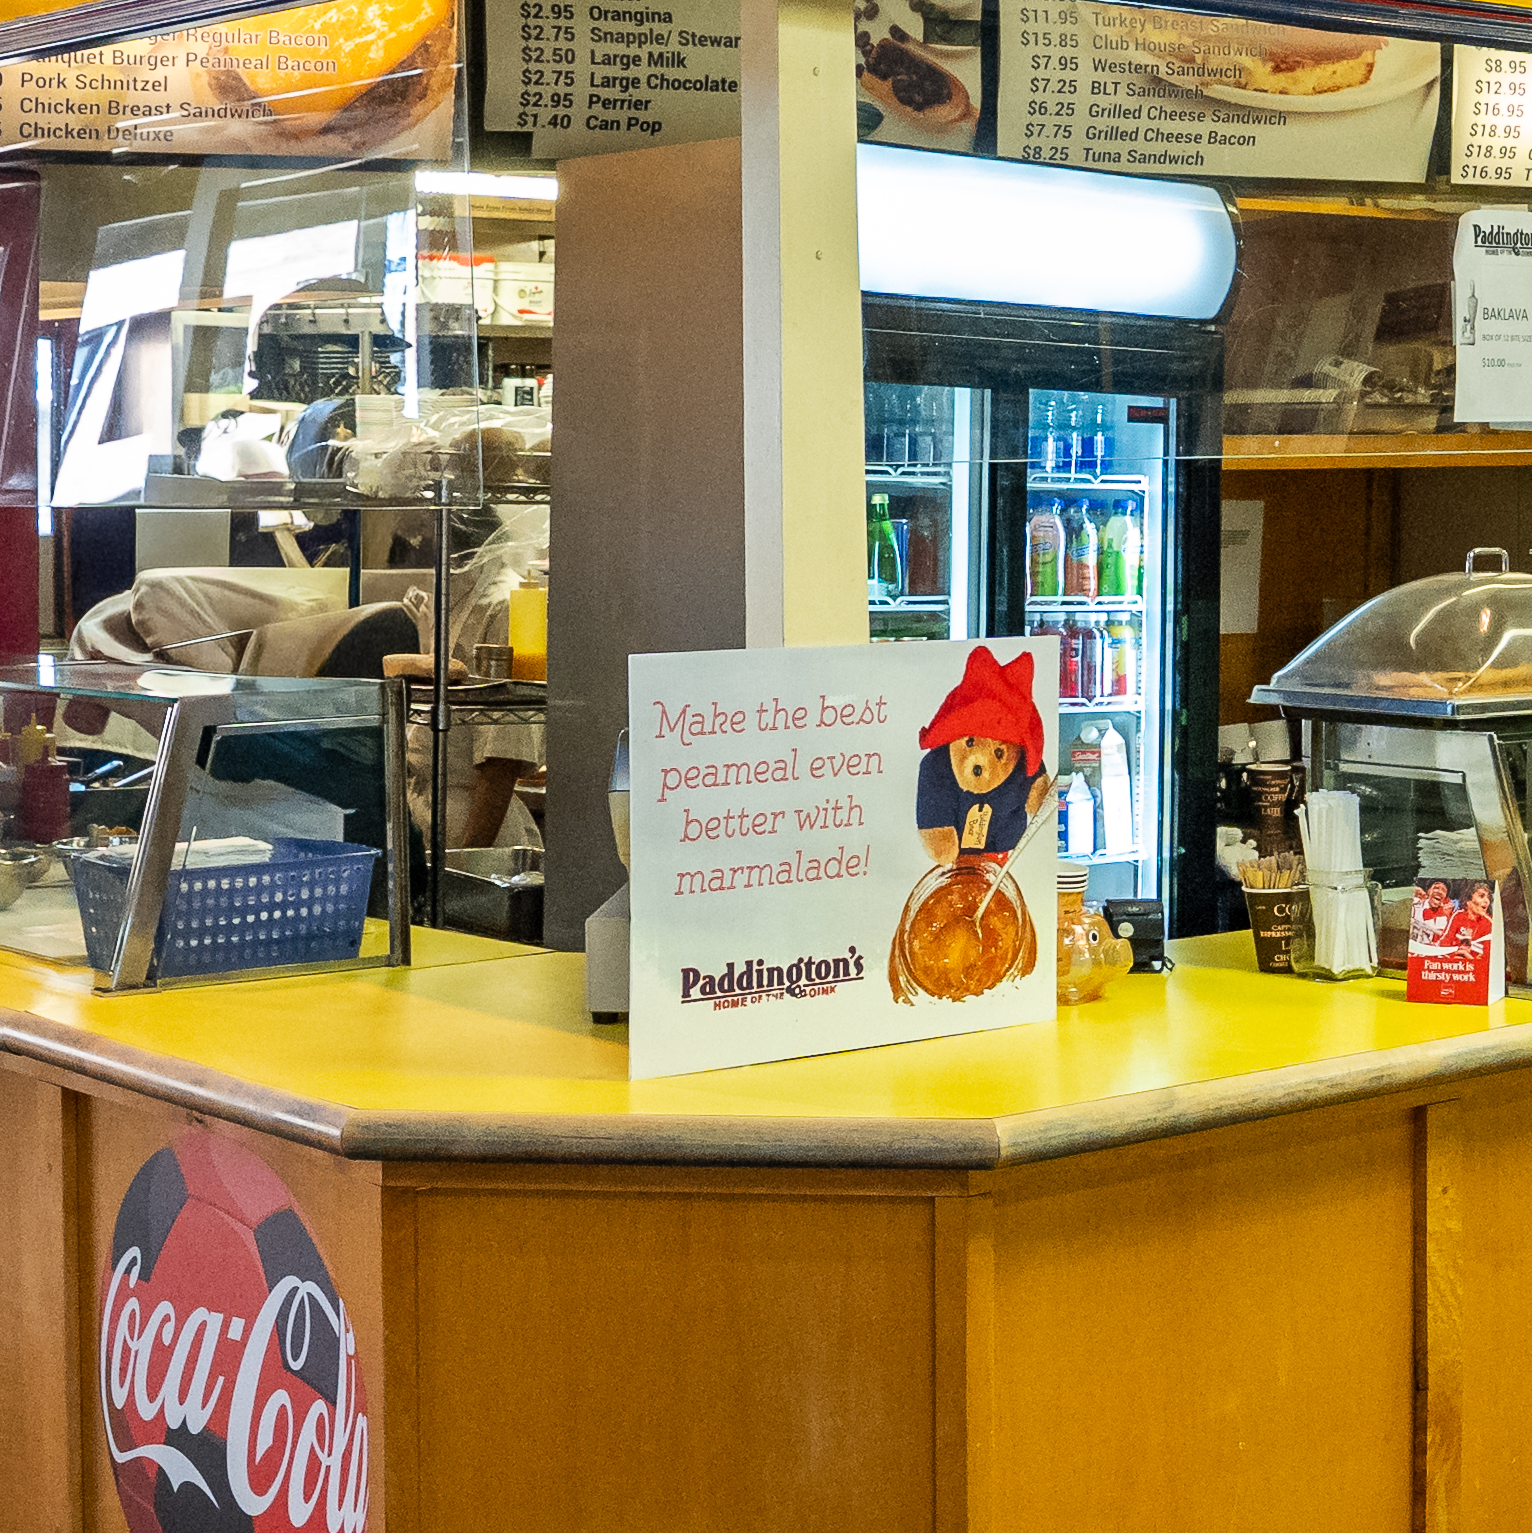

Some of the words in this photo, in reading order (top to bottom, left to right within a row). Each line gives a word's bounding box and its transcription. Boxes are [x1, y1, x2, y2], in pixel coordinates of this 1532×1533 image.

[520, 1, 575, 21] $2.95
[589, 6, 673, 27] Orangina
[1020, 8, 1079, 25] $11.95
[1092, 12, 1146, 32] Turkey
[1152, 15, 1204, 32] Breast
[1209, 18, 1286, 36] Sandwich
[186, 28, 261, 47] Regular
[269, 30, 329, 47] Bacon
[521, 23, 575, 42] $2.75
[590, 27, 673, 49] Snapple/
[678, 30, 741, 49] Stewar
[1021, 31, 1079, 49] $15.85
[1093, 34, 1129, 51] Club
[1135, 38, 1185, 55] House
[1192, 40, 1268, 58] Sandwich
[113, 50, 178, 70] Burger
[186, 52, 270, 70] Peameal
[277, 55, 336, 73] Bacon
[521, 45, 576, 64] $2.50
[590, 49, 642, 70] Large
[648, 51, 688, 69] Milk
[1031, 54, 1079, 72] $7.95
[1092, 58, 1160, 75] Western
[1165, 61, 1243, 79] Sandwich
[1485, 58, 1527, 74] $8.95
[21, 72, 67, 89] Pork
[76, 74, 168, 92] Schnitzel
[521, 67, 575, 87] $2.75
[590, 72, 641, 93] Large
[646, 74, 738, 93] Chocolate
[1030, 77, 1077, 95] $7.25
[1091, 80, 1121, 96] BLT
[1126, 82, 1204, 101] Sandwich
[1475, 80, 1527, 97] $12.95
[20, 97, 100, 115] Chicken
[108, 100, 172, 117] Breast
[179, 102, 273, 120] Sandwich
[519, 90, 573, 109] $2.95
[587, 94, 652, 112] Perrier
[1473, 101, 1524, 118] $16.95
[517, 111, 572, 129] $1.40
[586, 116, 620, 131] Can
[627, 117, 662, 136] Pop
[1027, 100, 1075, 118] $6.25
[1089, 103, 1142, 121] Grilled
[1147, 106, 1206, 123] Cheese
[1211, 108, 1287, 126] Sandwich
[19, 122, 99, 140] Chicken
[107, 124, 174, 142] Deluxe
[1024, 123, 1073, 140] $7.75
[1085, 125, 1139, 143] Grilled
[1144, 128, 1203, 145] Cheese
[1207, 131, 1256, 147] Bacon
[1469, 123, 1521, 140] $18.95
[1021, 145, 1069, 162] $8.25
[1083, 147, 1121, 164] Tuna
[1127, 148, 1205, 166] Sandwich
[1465, 144, 1517, 160] $18.95
[1461, 164, 1513, 181] $16.95
[1482, 307, 1529, 322] BAKLAVA
[1481, 334, 1493, 342] BOX
[1495, 334, 1503, 342] OF
[1481, 357, 1506, 368] $10.00
[653, 699, 748, 747] Make
[756, 696, 811, 733] the
[816, 693, 889, 730] best
[657, 747, 800, 803] peameal
[809, 749, 884, 779] even
[679, 807, 786, 843] better
[793, 794, 865, 833] with
[673, 844, 871, 897] marmalade!
[680, 945, 865, 999] Paddington's
[1421, 970, 1452, 983] thirsty
[1452, 971, 1476, 982] work
[1424, 959, 1441, 970] Fan
[1441, 960, 1465, 971] work
[1466, 961, 1475, 971] is
[713, 996, 748, 1012] HOME
[750, 994, 764, 1005] OF
[766, 992, 785, 1003] THE
[808, 984, 838, 999] OINK
[99, 1245, 369, 1533] Coca-Cola
